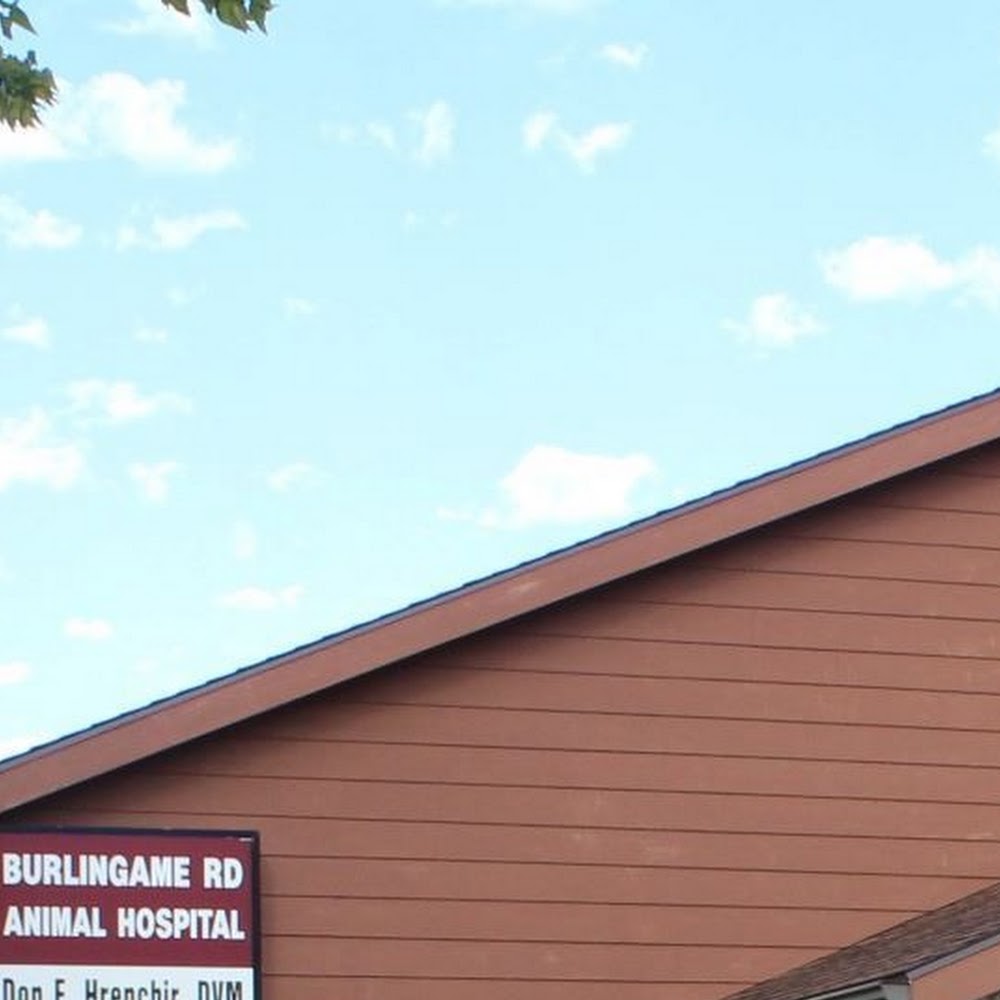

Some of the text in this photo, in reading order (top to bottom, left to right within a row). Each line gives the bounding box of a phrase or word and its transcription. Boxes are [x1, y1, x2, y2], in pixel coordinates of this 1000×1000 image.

[3, 853, 244, 889] BURLINGAME RD
[3, 906, 246, 940] ANIMAL HOSPITAL
